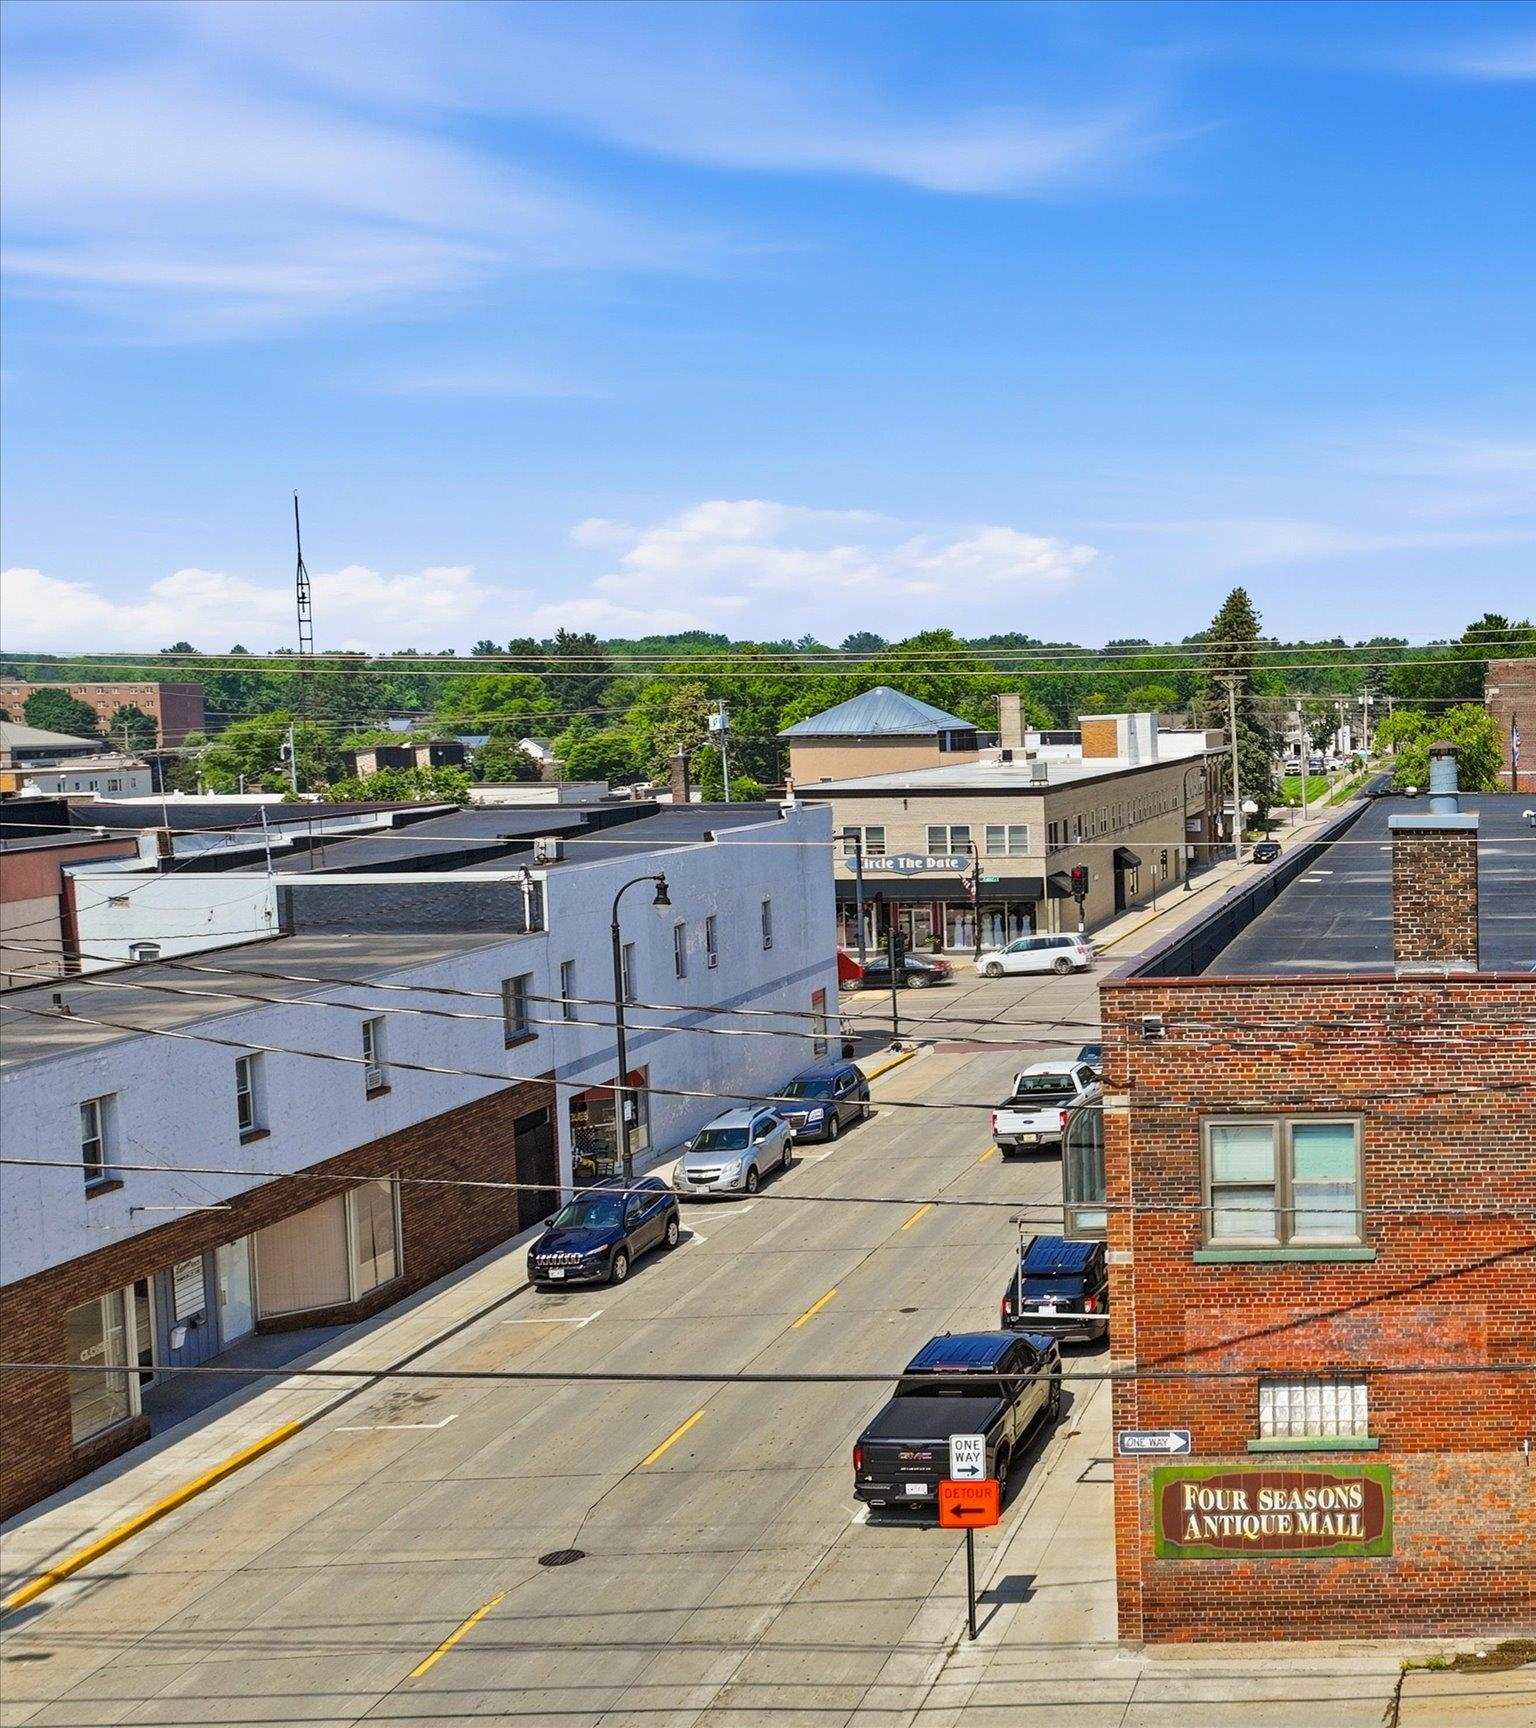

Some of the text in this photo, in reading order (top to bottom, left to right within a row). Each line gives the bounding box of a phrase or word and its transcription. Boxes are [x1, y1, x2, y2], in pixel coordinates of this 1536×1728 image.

[898, 857, 923, 869] The
[926, 857, 959, 869] Date
[955, 1440, 980, 1451] ONE
[1126, 1437, 1168, 1447] ONE WAY
[955, 1453, 980, 1462] WAY
[944, 1488, 993, 1499] DETOUR
[1183, 1484, 1363, 1511] FOUR SEASONS
[1183, 1512, 1364, 1540] ANTIQUE MALL
